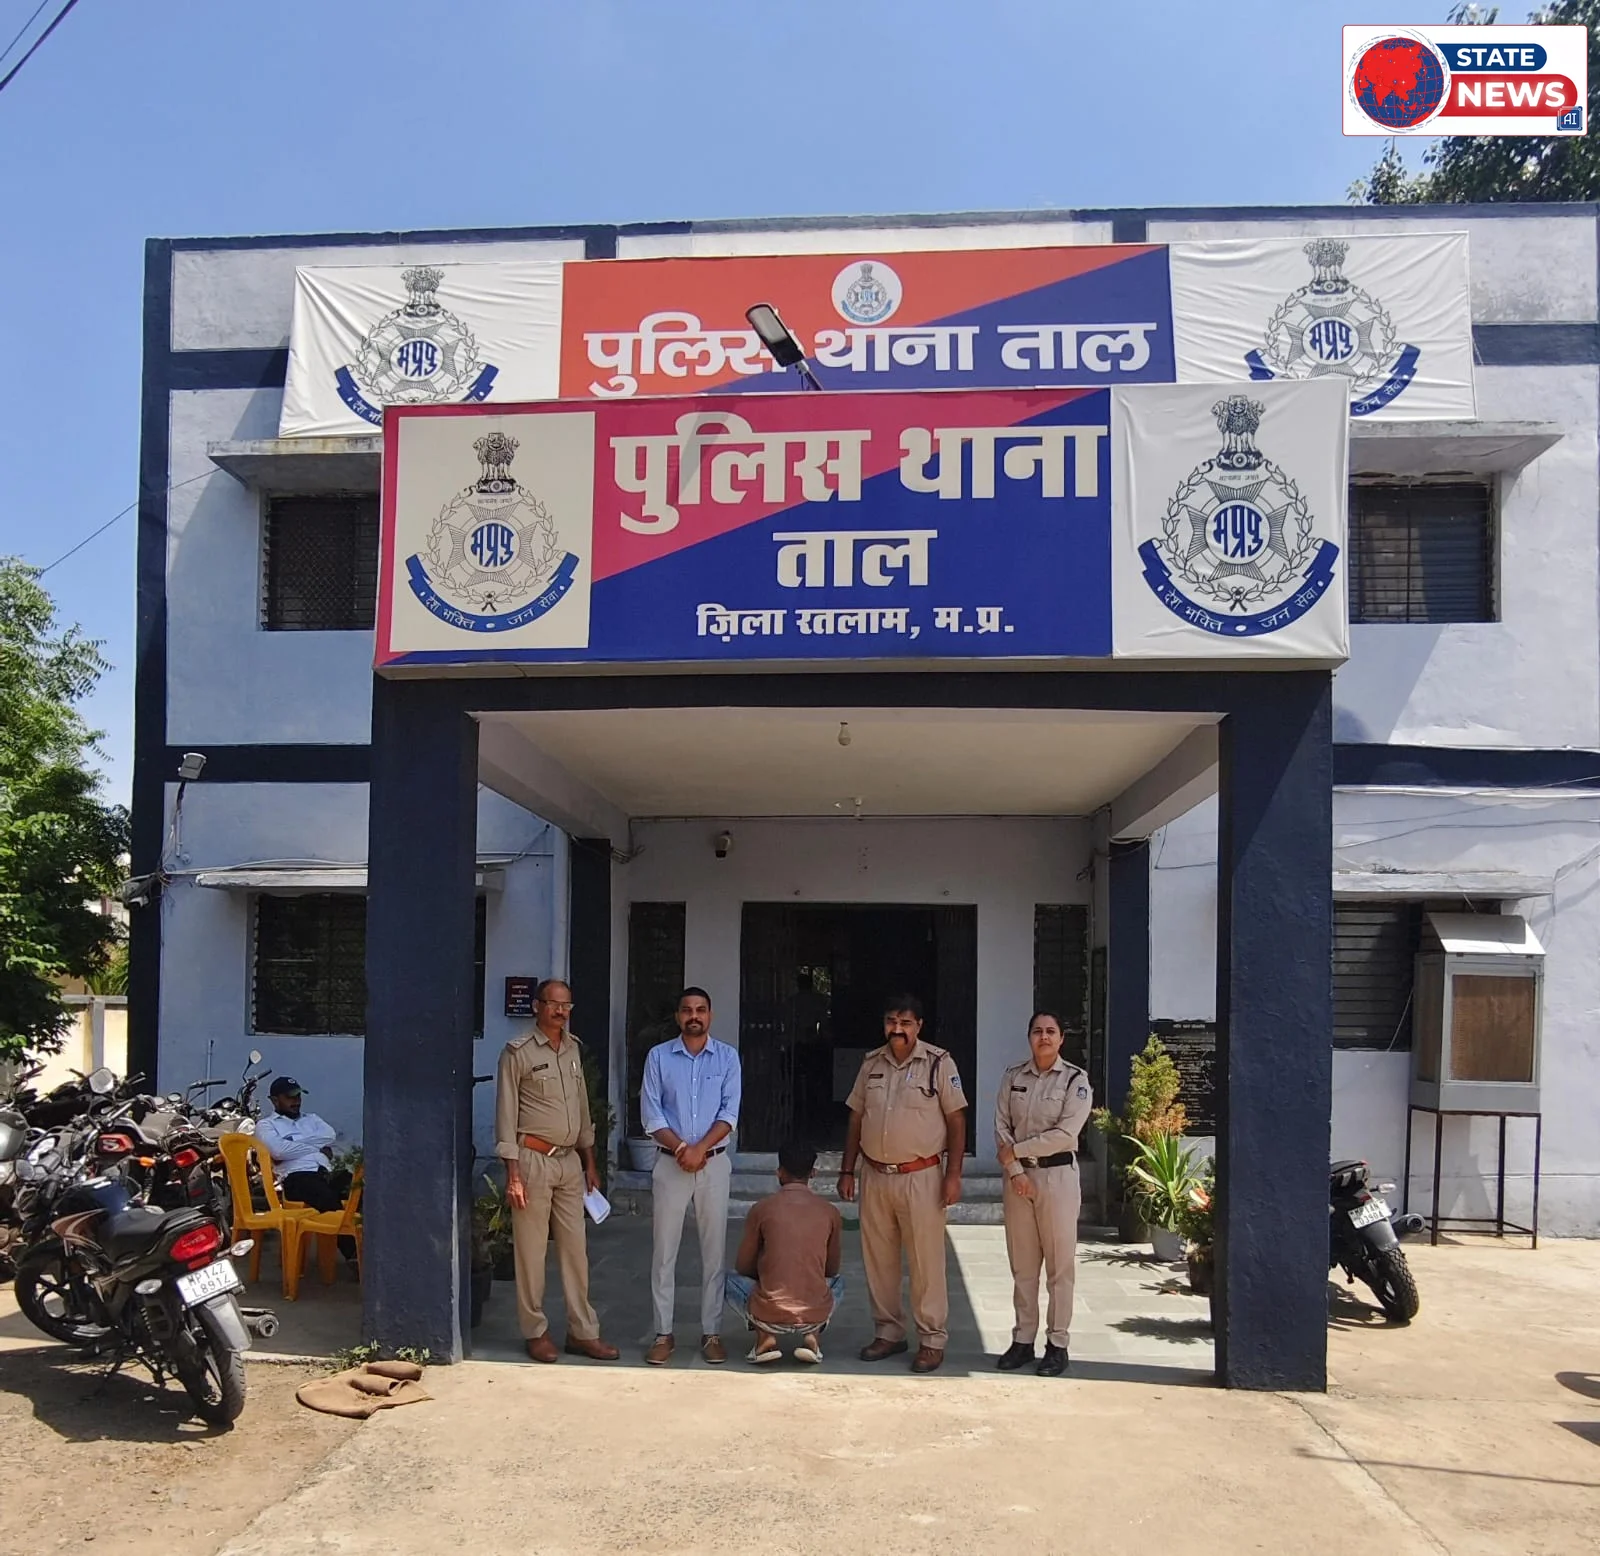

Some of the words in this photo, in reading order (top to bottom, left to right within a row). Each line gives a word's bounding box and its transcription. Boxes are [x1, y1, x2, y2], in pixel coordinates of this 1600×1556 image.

[814, 325, 980, 371] थाना
[997, 322, 1158, 372] ताल
[609, 411, 872, 535] पुलिस
[899, 425, 1108, 500] थाना
[772, 529, 938, 588] ताल
[425, 594, 442, 612] देश
[507, 608, 534, 626] जन
[538, 590, 560, 608] सेवा
[794, 607, 921, 640] रतलाम,
[932, 607, 1015, 635] म.प्र.
[1164, 588, 1182, 610] देश
[1185, 605, 1225, 632] भक्ति
[1257, 606, 1291, 629] जन
[1294, 586, 1319, 609] सेवा
